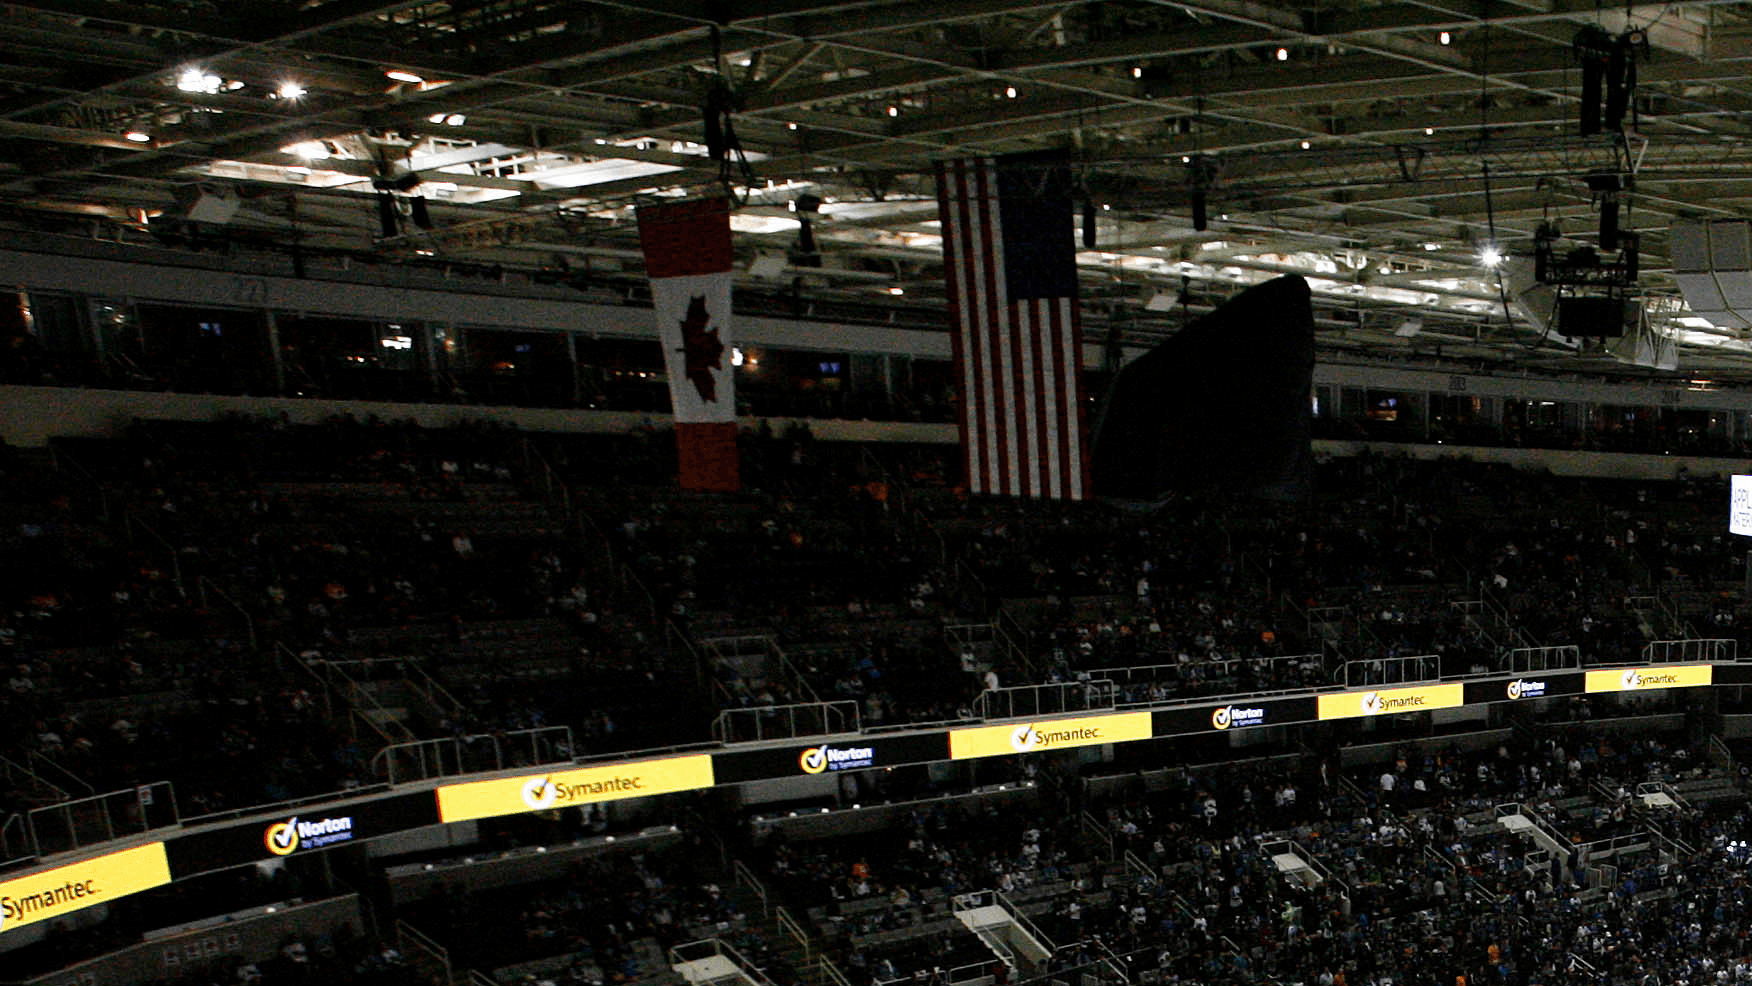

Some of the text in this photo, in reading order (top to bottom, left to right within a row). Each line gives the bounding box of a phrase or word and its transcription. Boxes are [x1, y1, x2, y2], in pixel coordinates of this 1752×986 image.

[1636, 674, 1677, 687] Symantec
[1379, 695, 1424, 711] Symantec
[1232, 708, 1265, 720] Norton
[1035, 727, 1100, 746] Symantec
[827, 748, 873, 762] Norton
[555, 777, 641, 801] Symantec
[298, 816, 352, 838] Norton
[1, 878, 95, 921] Symantec
